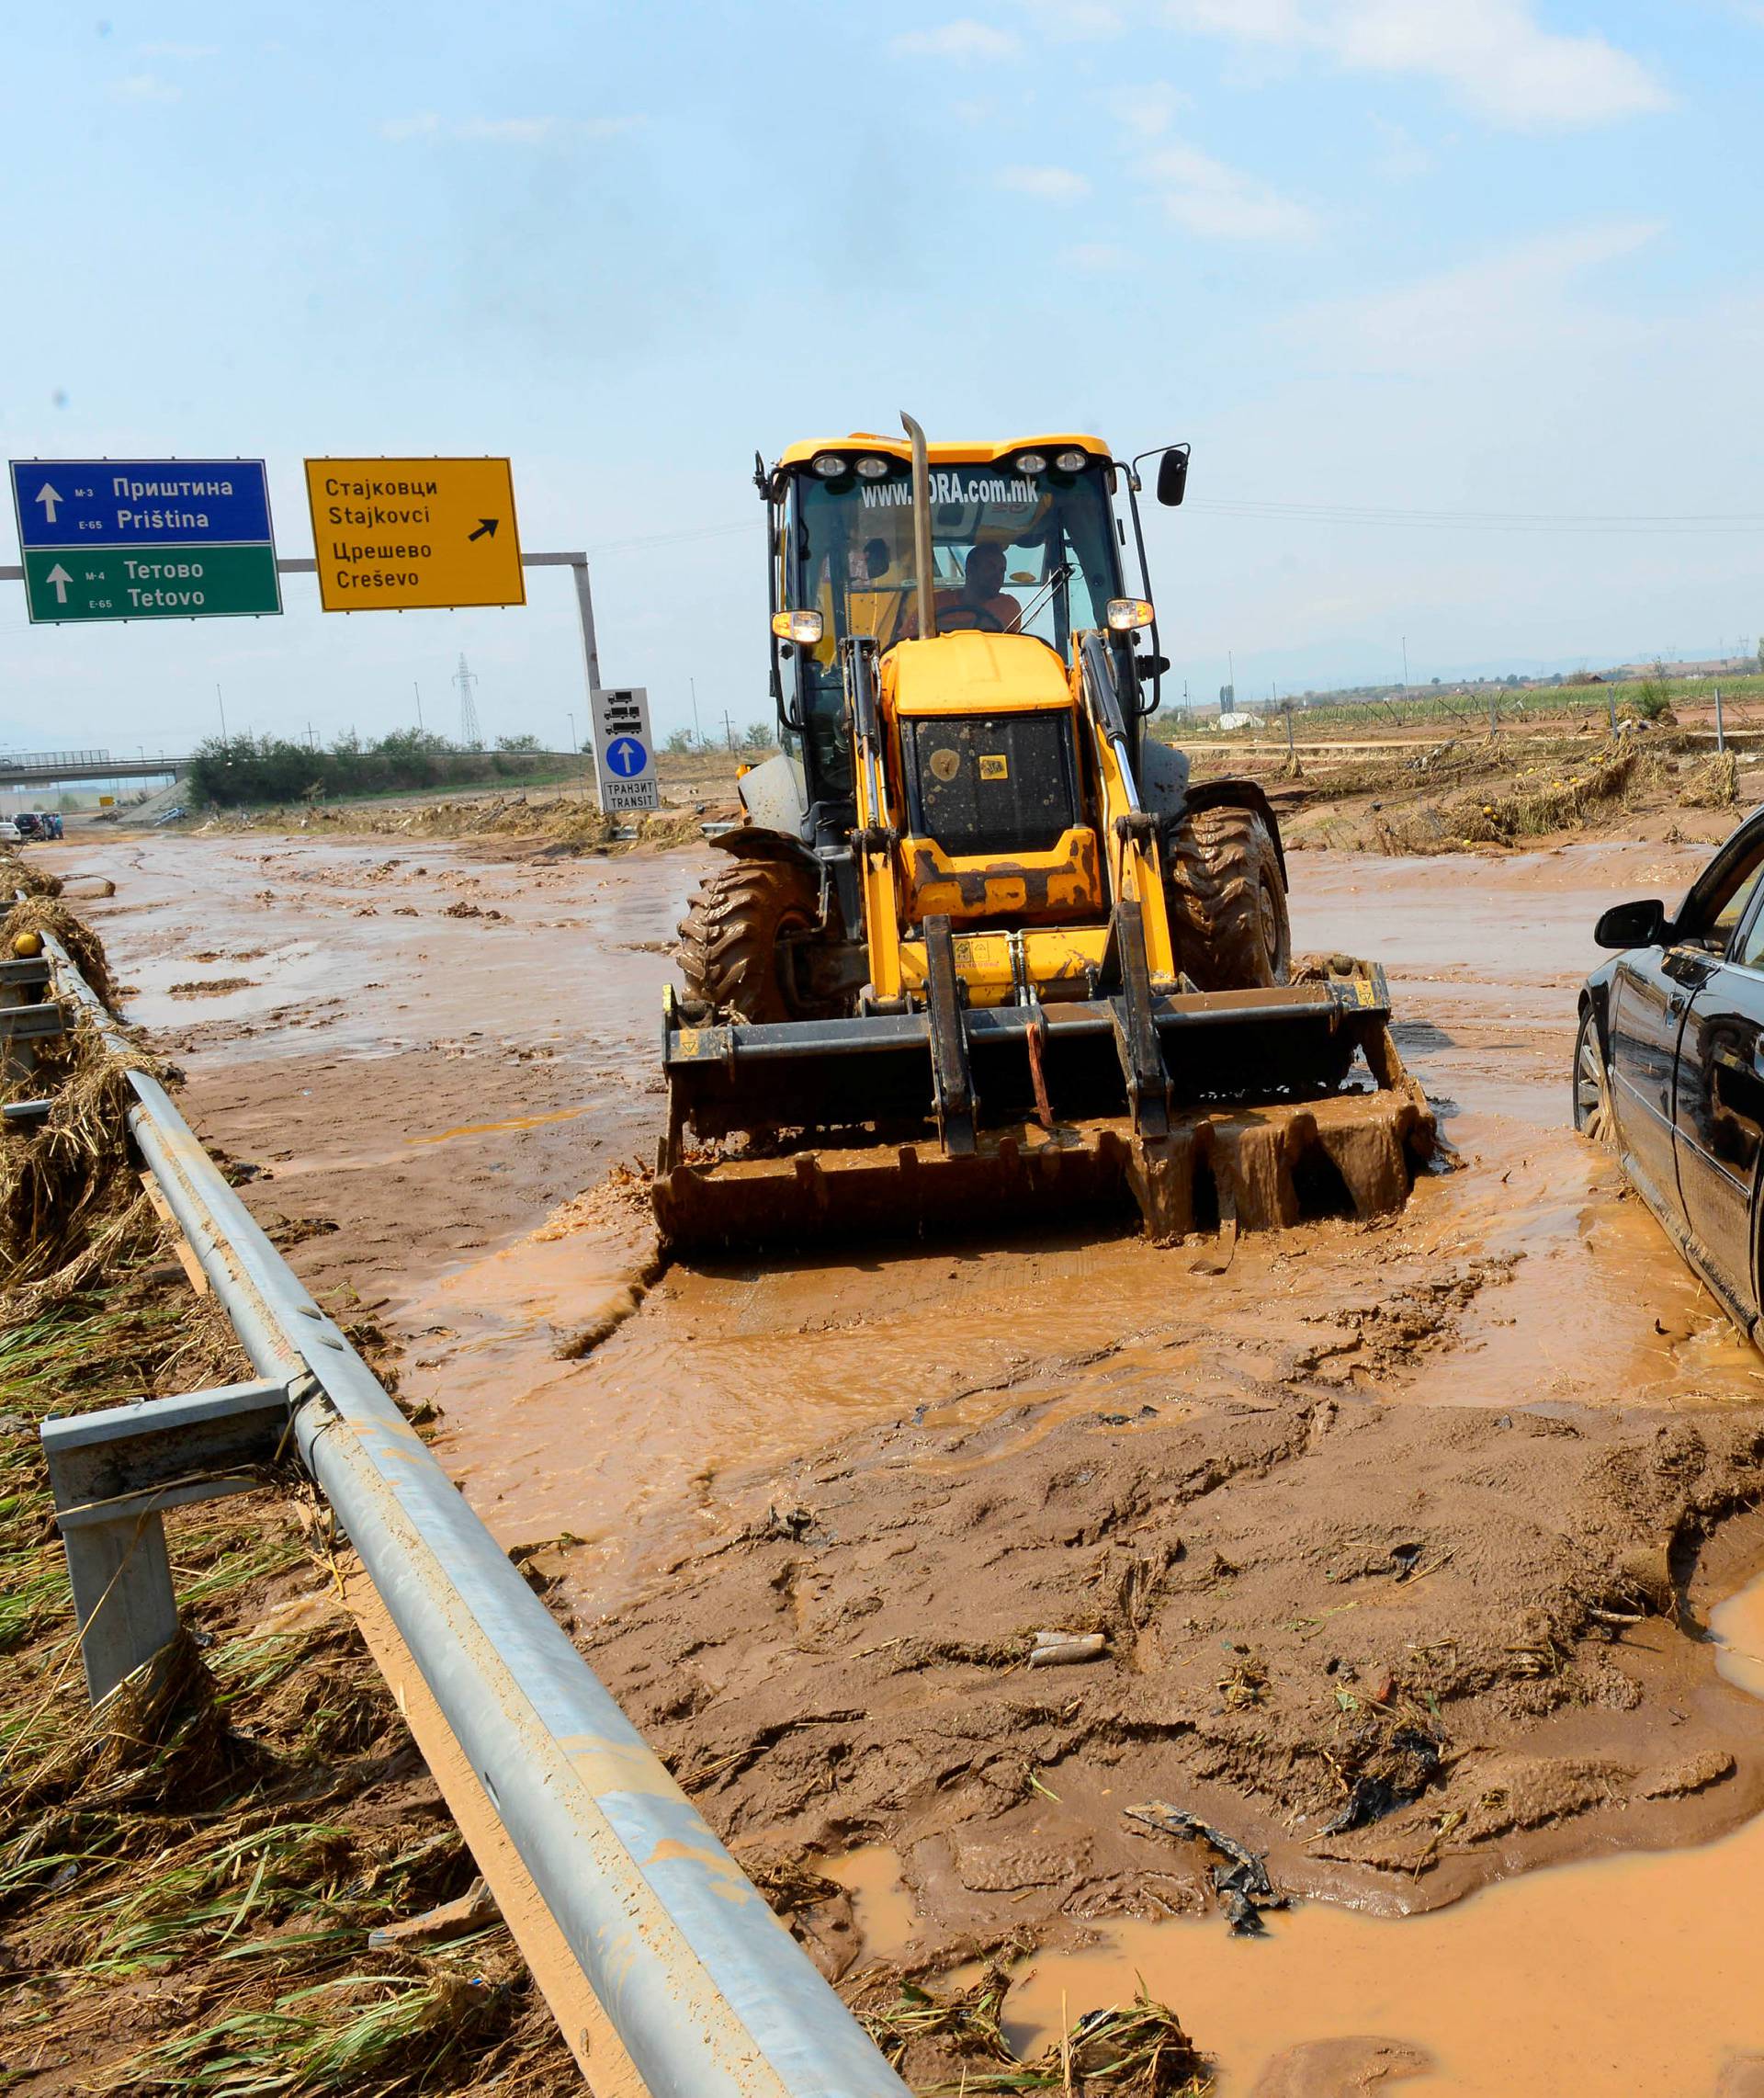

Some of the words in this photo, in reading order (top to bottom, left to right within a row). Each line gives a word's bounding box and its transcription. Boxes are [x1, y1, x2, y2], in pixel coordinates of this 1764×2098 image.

[114, 477, 233, 501] Приштина
[325, 479, 436, 499] Стајковци
[117, 510, 209, 529] Priština
[329, 506, 430, 527] Stajkovci
[334, 542, 432, 562] Црешево
[124, 561, 204, 580] Тетово
[337, 571, 419, 588] Creševo
[128, 589, 205, 607] Tetovo
[607, 782, 652, 795] ТРАНЗИТ
[611, 796, 652, 809] TRANSIT
